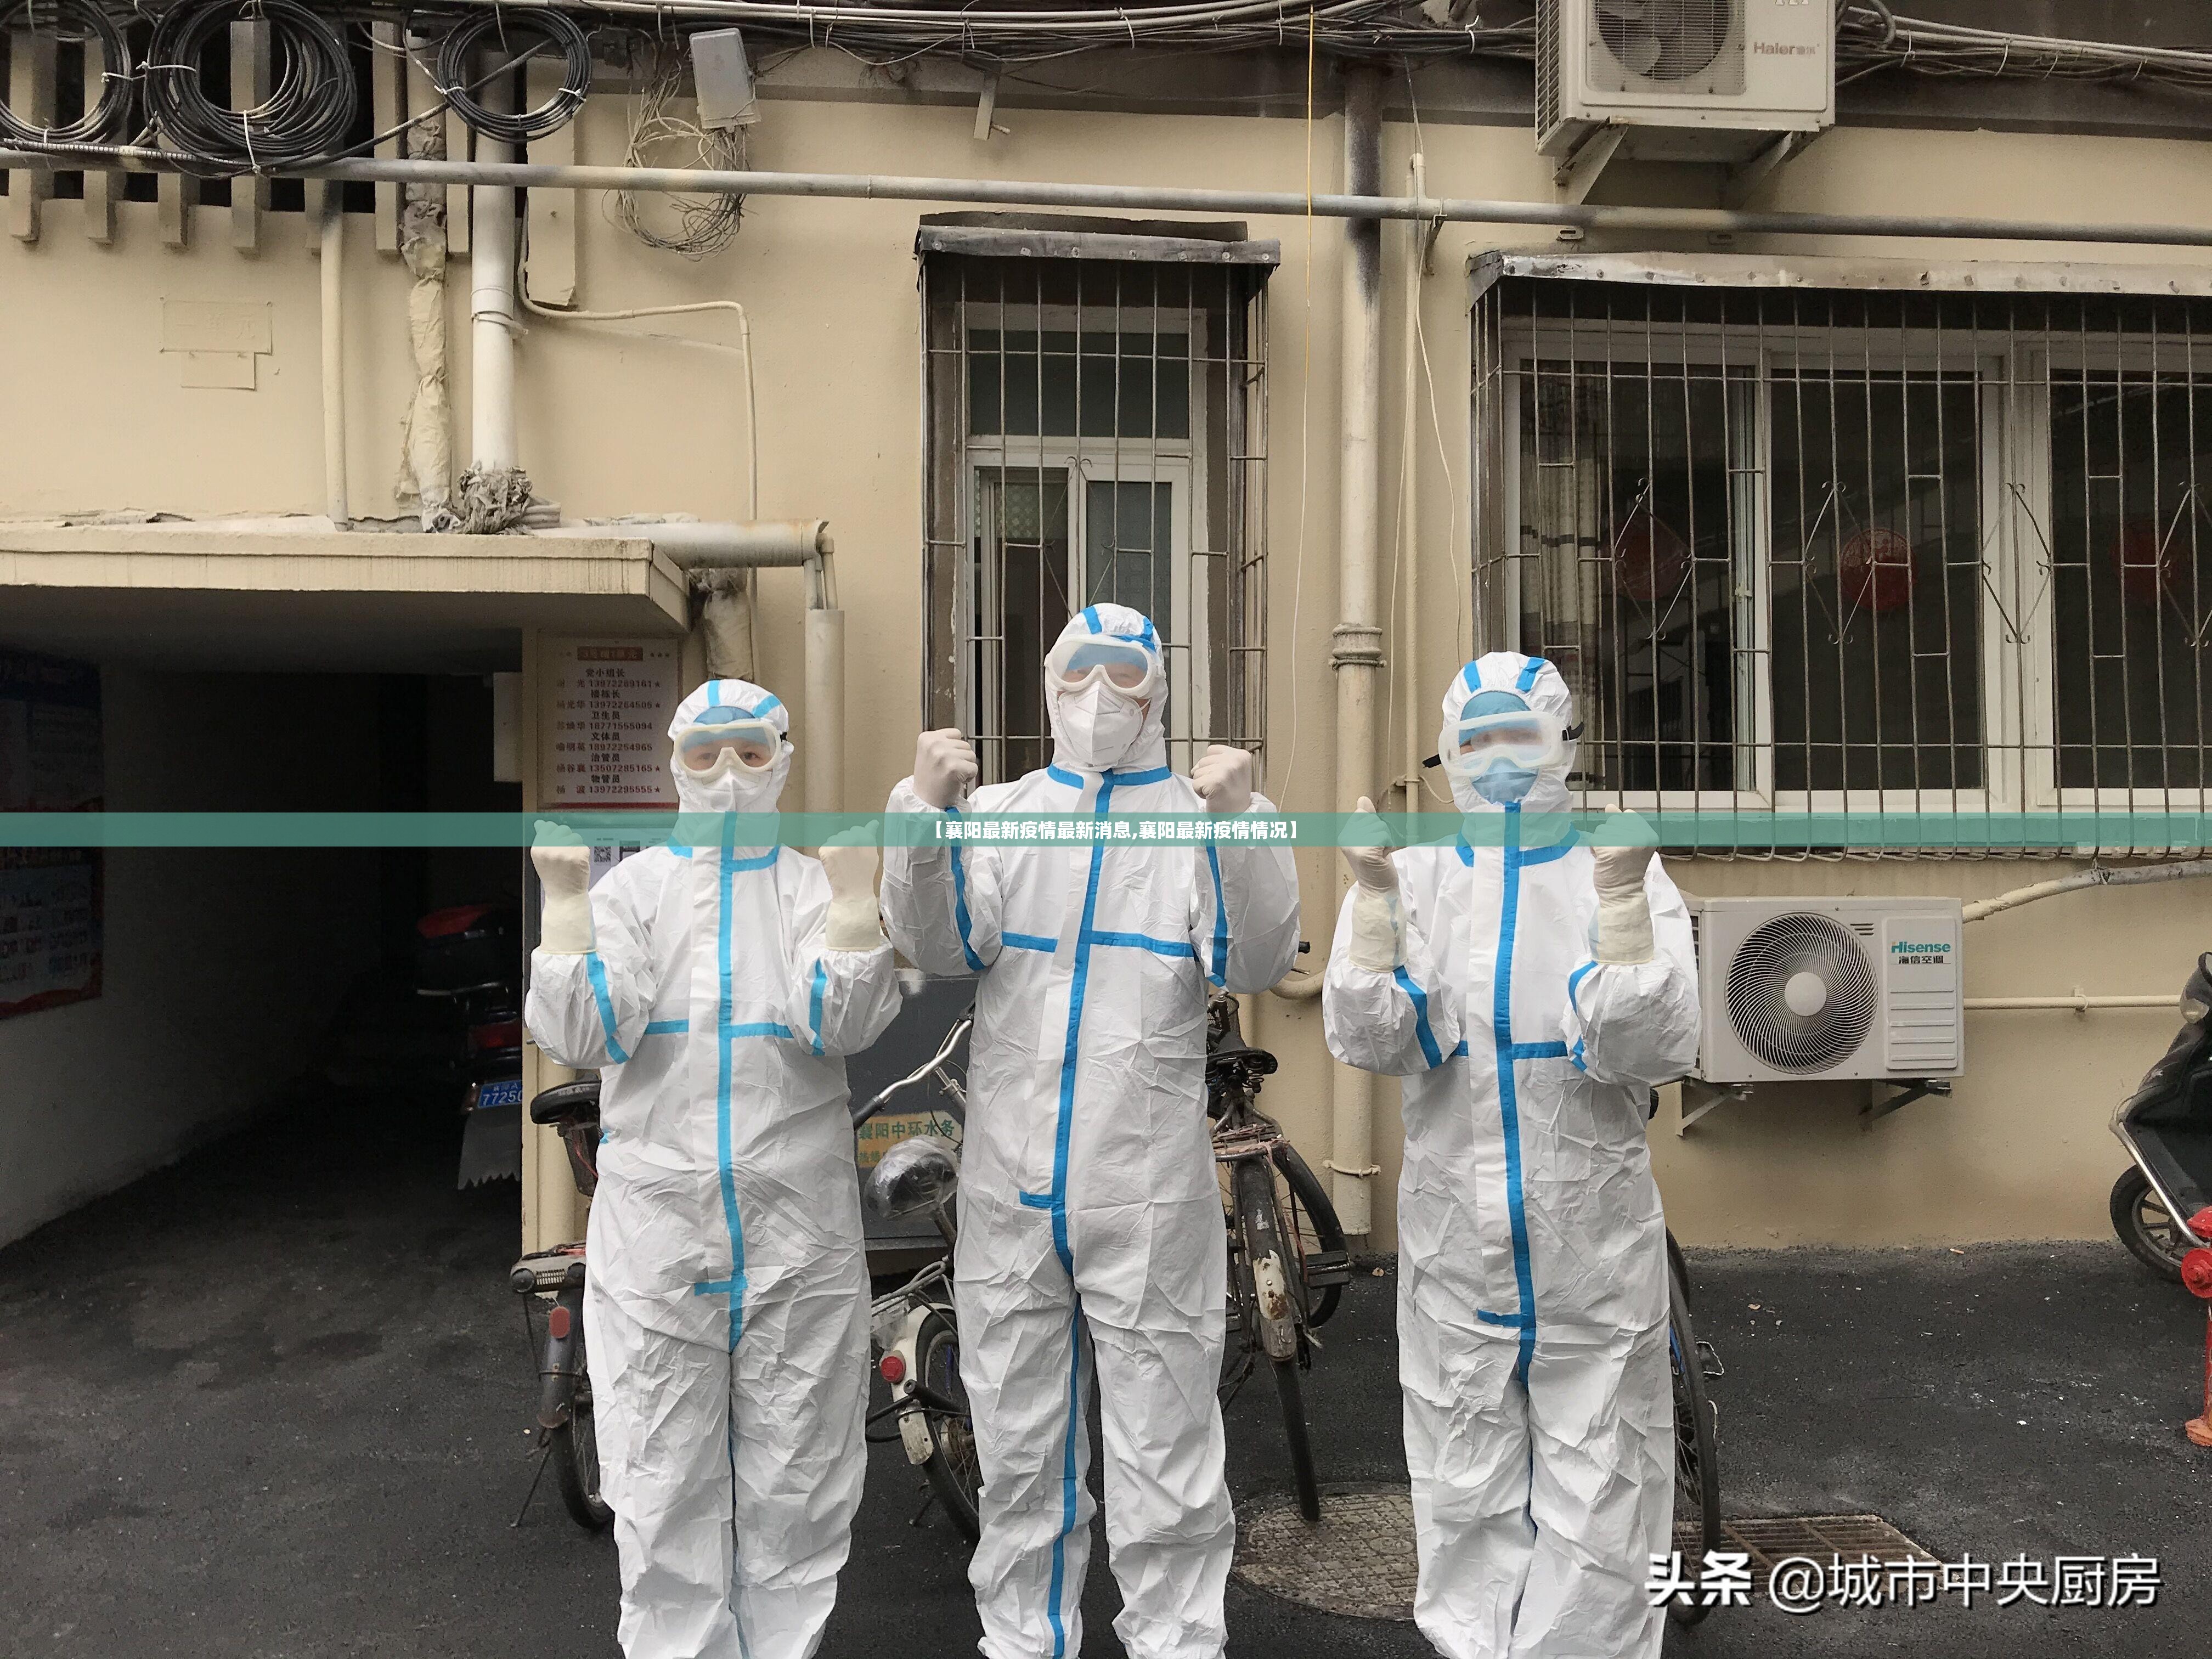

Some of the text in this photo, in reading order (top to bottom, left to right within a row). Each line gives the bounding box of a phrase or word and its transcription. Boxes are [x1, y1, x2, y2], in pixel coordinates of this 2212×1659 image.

[591, 732, 620, 741] 文体员
[591, 774, 620, 783] 物管员
[1891, 941, 1951, 953] Hisense
[1898, 955, 1944, 964] 海信空调
[859, 1119, 955, 1139] 襄阳中环水务
